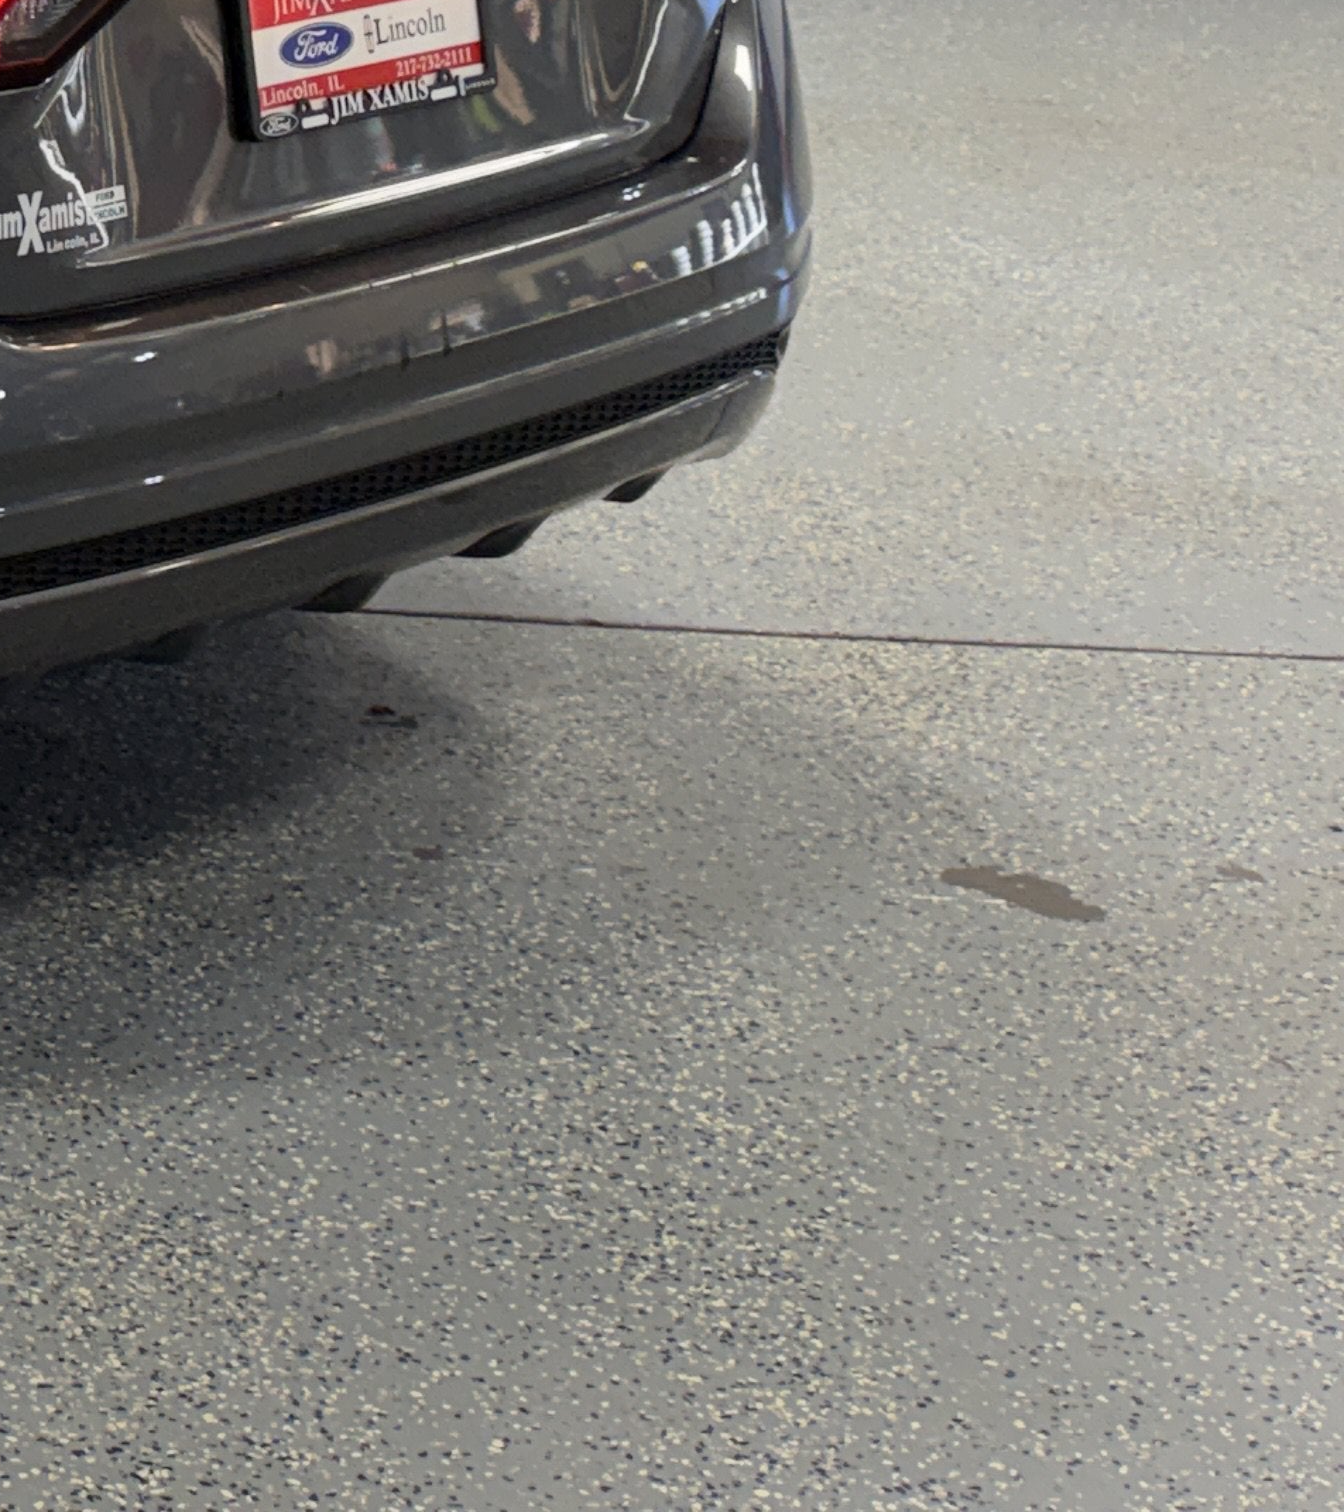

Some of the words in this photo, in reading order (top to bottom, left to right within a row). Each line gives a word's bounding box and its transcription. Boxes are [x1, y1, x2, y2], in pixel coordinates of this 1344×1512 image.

[373, 6, 448, 46] Lincoln
[293, 28, 339, 62] Ford
[395, 45, 473, 77] 217-732-2111
[328, 75, 346, 93] IL
[330, 91, 365, 126] JIM
[366, 79, 431, 112] XAMIS
